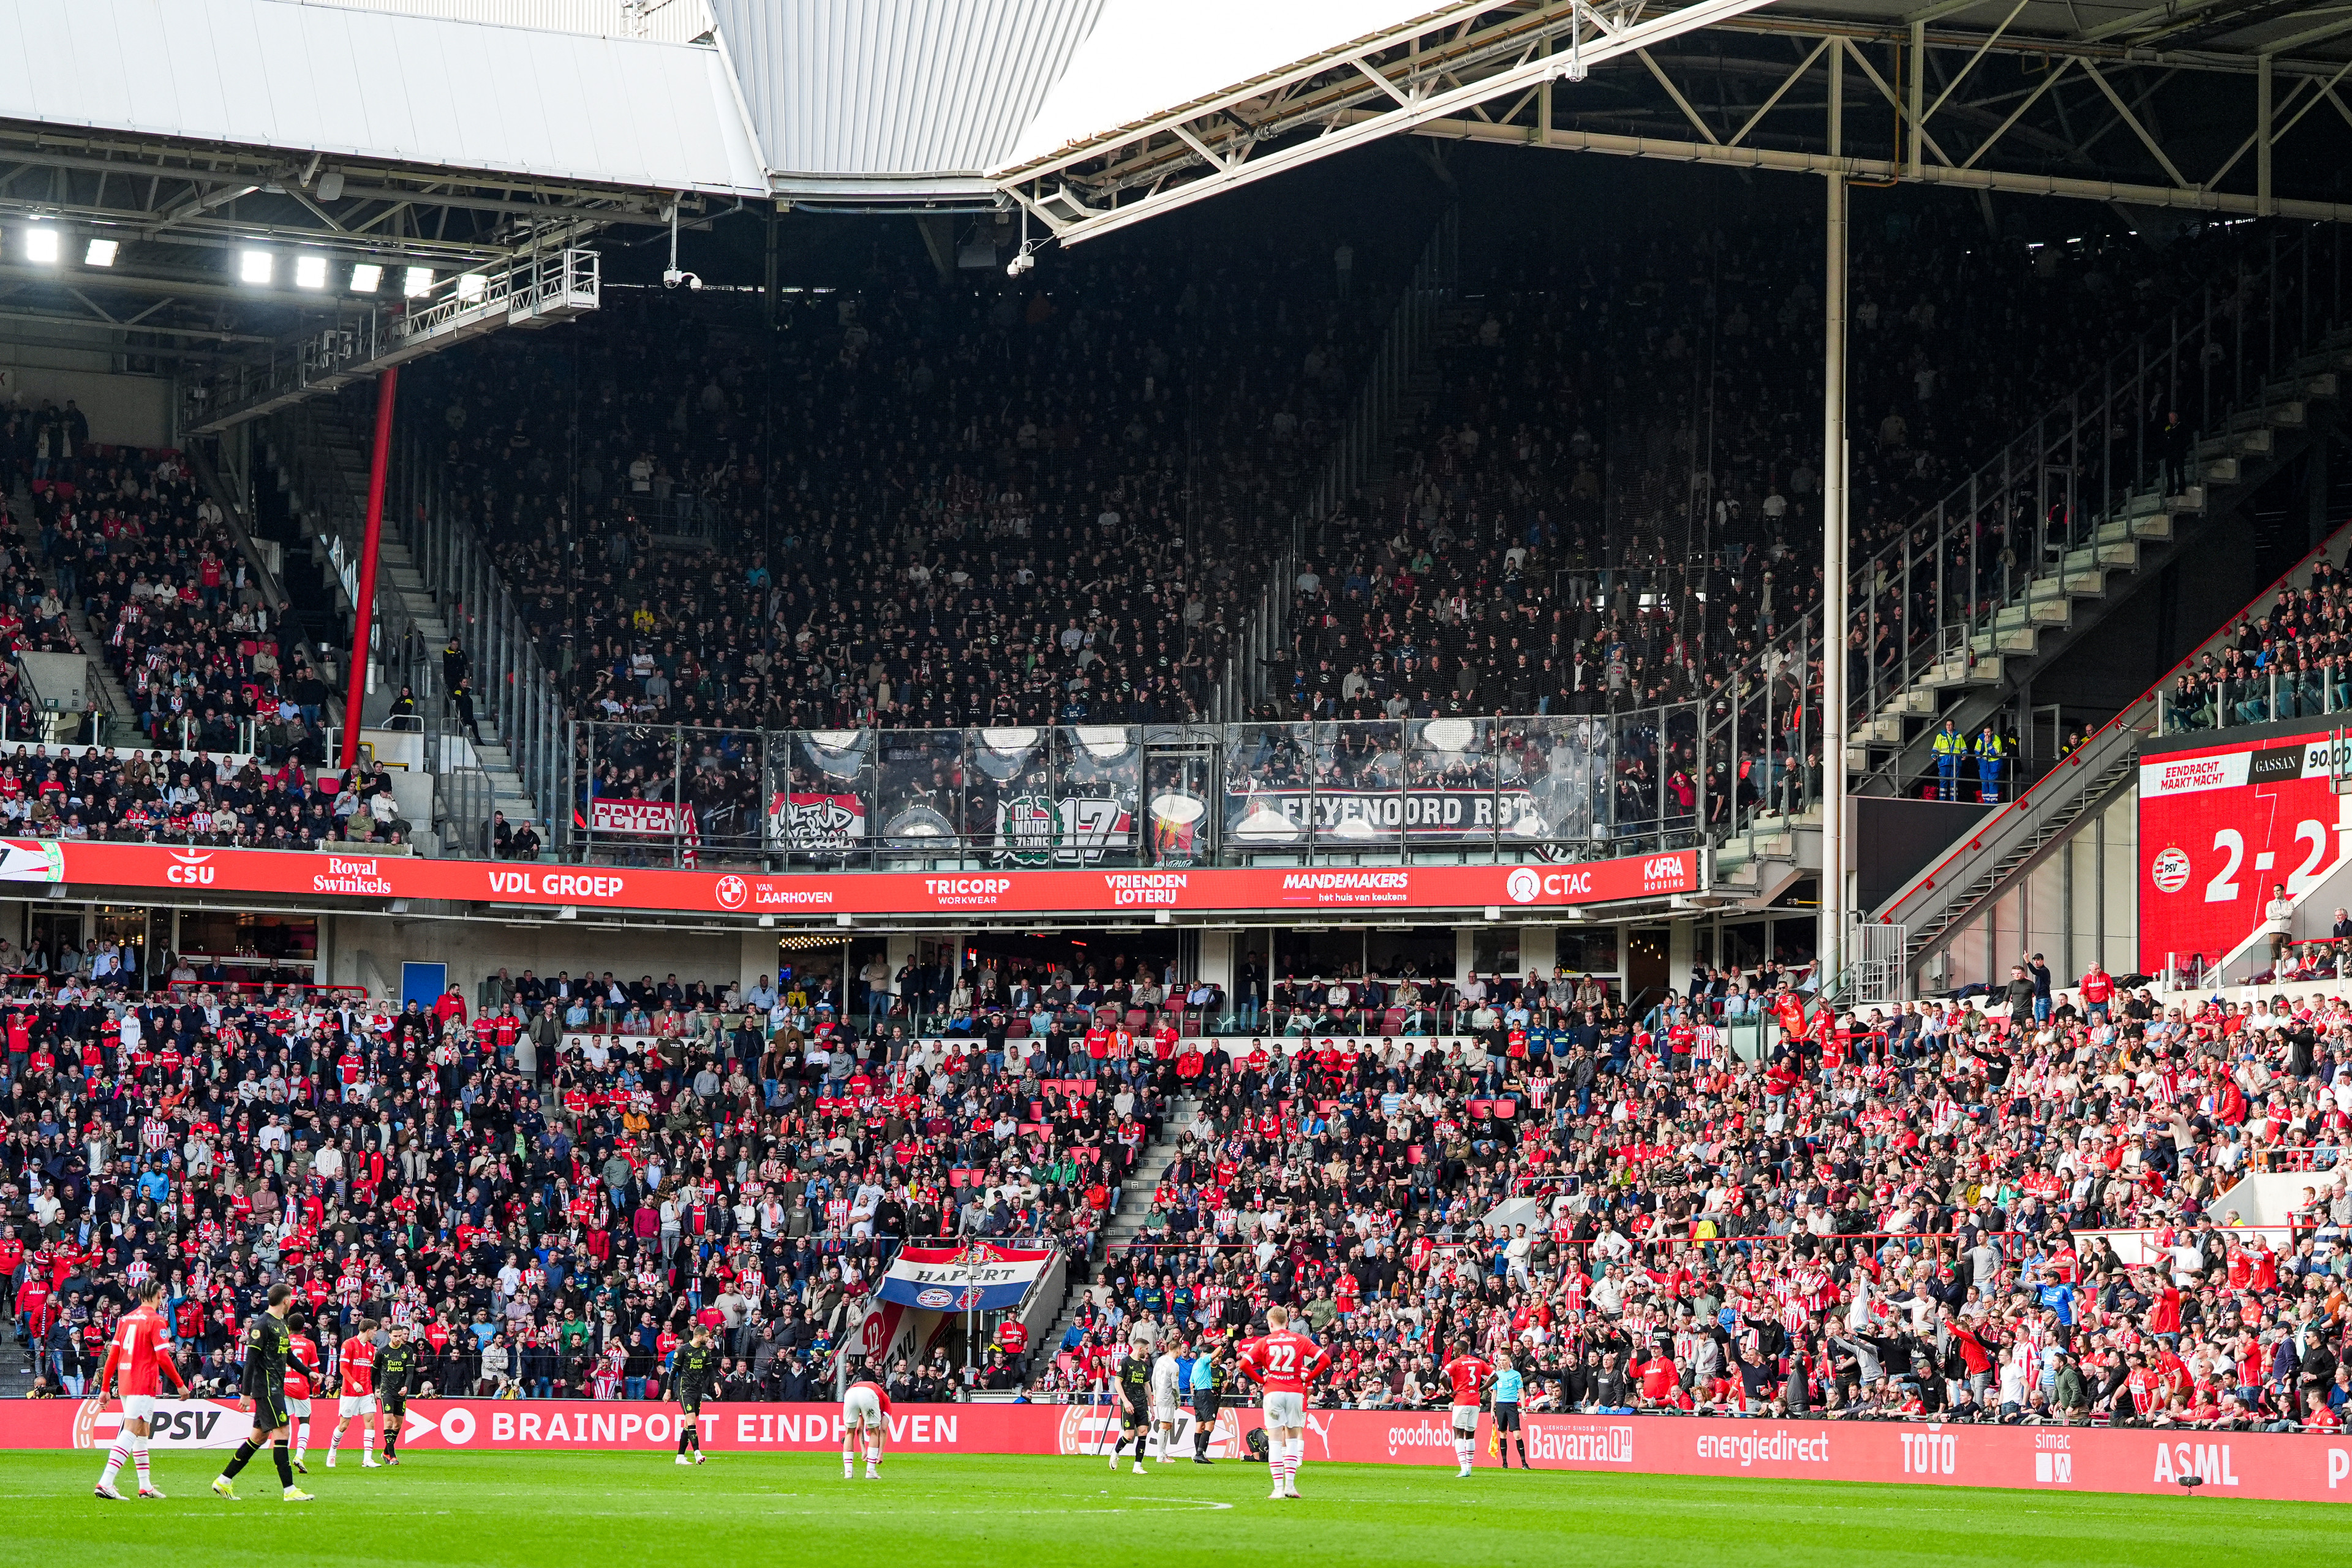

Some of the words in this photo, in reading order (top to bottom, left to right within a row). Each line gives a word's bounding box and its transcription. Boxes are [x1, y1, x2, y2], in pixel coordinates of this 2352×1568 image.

[2165, 761, 2220, 778] EENDRACHT
[2255, 756, 2296, 772] GASSAN
[2160, 775, 2192, 791] MAAKT
[2192, 772, 2225, 788] MACHT
[1014, 804, 1031, 821] DE
[1281, 797, 1462, 826] FEYENOORD
[1057, 799, 1117, 858] 17
[329, 858, 377, 880] Royal
[1644, 856, 1684, 881] KAFRA
[2164, 863, 2178, 873] PSV
[2204, 828, 2244, 903] 2
[2285, 819, 2326, 895] 2
[167, 865, 214, 884] CSU
[313, 875, 391, 894] Swinkels
[489, 872, 536, 894] VDL
[542, 873, 623, 897] GROEP
[925, 878, 1011, 894] TRICORP
[1105, 873, 1187, 889] VRIENDEN
[1283, 872, 1408, 889] MANDEMAKERS
[1544, 872, 1592, 896] CTAC
[1644, 877, 1685, 892] HOUSING
[756, 883, 773, 892] VAN
[756, 891, 832, 903] LAARHOVEN
[1115, 889, 1177, 905] LOTERIJ
[1335, 893, 1353, 902] huis
[1371, 892, 1408, 902] keukens
[938, 895, 997, 905] WORKWEAR
[123, 1324, 137, 1355] 4
[868, 1322, 880, 1354] 12
[1268, 1344, 1296, 1373] 22
[1468, 1366, 1477, 1386] 3
[149, 1411, 222, 1441] PSV
[737, 1414, 957, 1443] EINDHVEN
[1147, 1418, 1188, 1445] SV
[1388, 1419, 1455, 1457] goodhabi
[1528, 1424, 1608, 1461] Bavaria
[1611, 1428, 1630, 1459] 0.0
[1697, 1430, 1829, 1467] energiedirect
[2035, 1428, 2071, 1450] simac
[1901, 1433, 1955, 1475] TOTO
[2154, 1442, 2239, 1485] ASML
[2328, 1448, 2350, 1488] P
